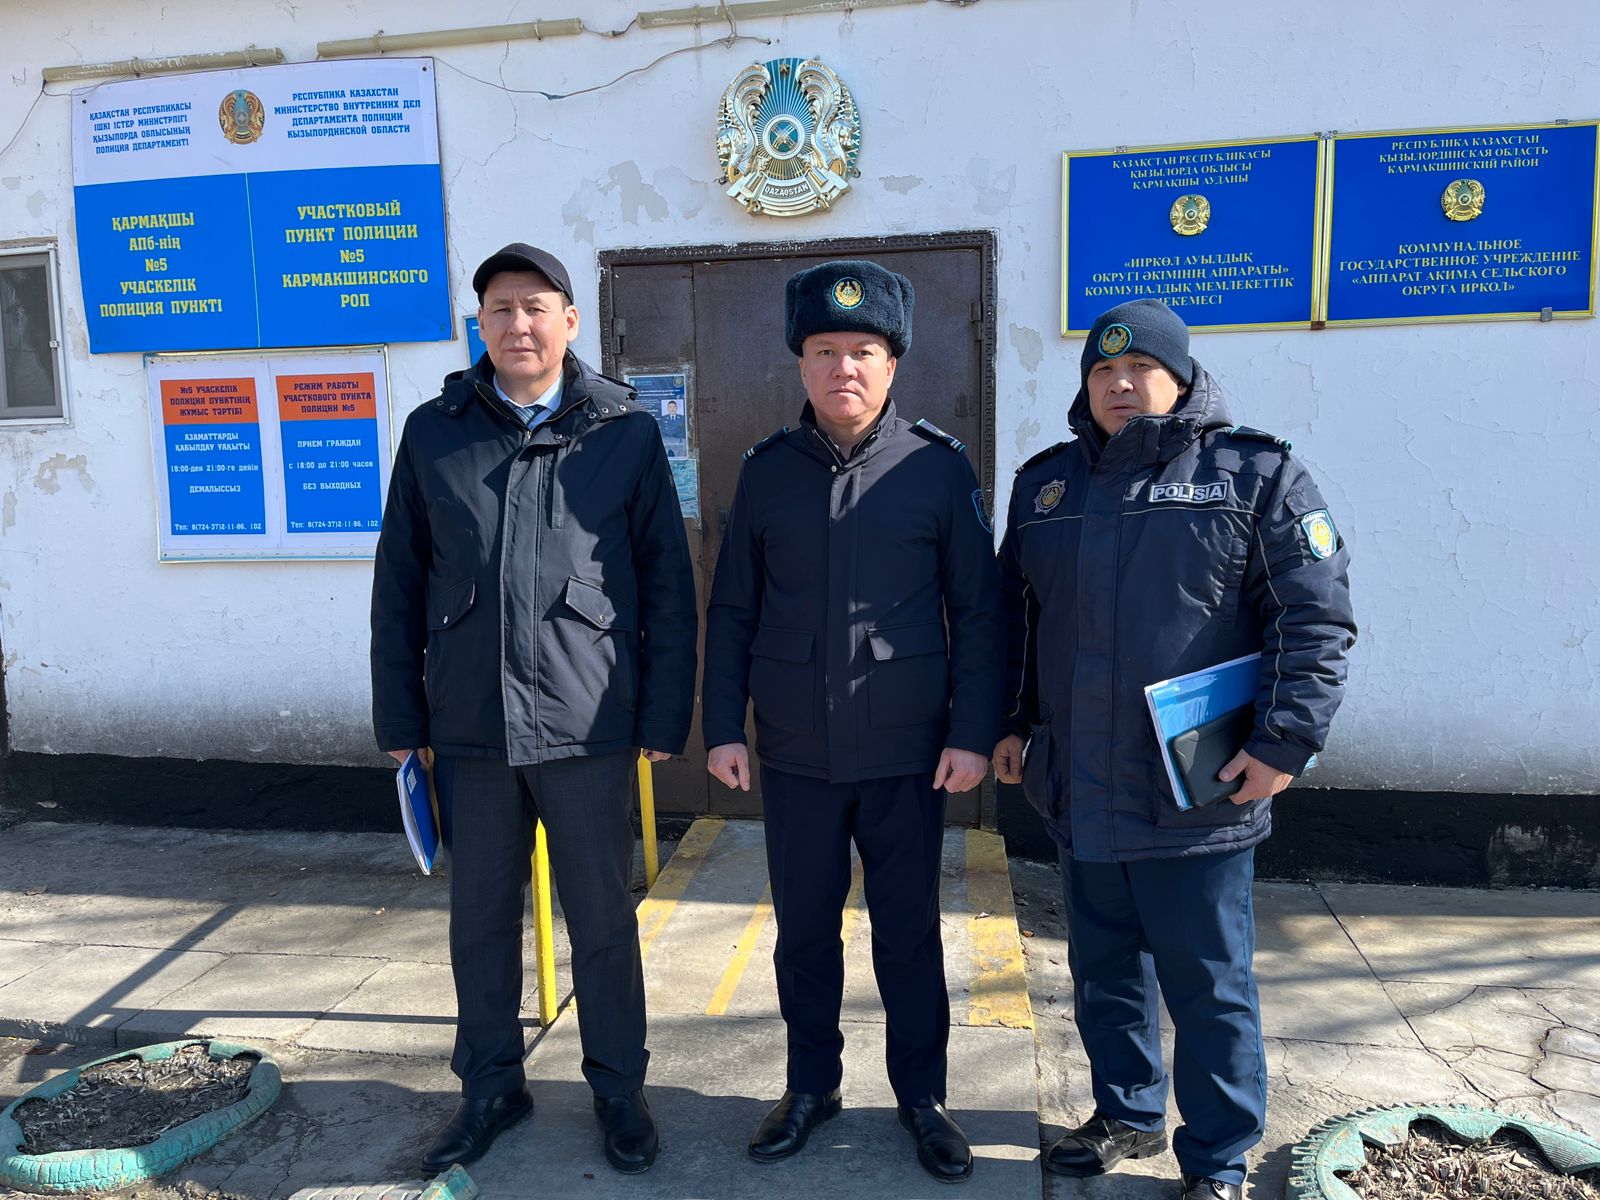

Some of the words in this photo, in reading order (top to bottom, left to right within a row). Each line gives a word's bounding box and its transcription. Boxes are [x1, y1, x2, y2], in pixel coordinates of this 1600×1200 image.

[292, 90, 346, 101] РЕСПУБЛИКА
[350, 88, 398, 98] КАЗАХСТАН
[90, 109, 130, 121] ҚАЗАҚСТАН
[133, 102, 192, 116] РЕСПУБЛИКАСЫ
[274, 103, 339, 115] МИНИСТЕРСТВО
[343, 100, 399, 110] ВНУТРЕННИХ
[403, 100, 420, 109] ДЕЛ
[94, 123, 110, 132] ІШКІ
[114, 120, 134, 129] ІСТЕР
[138, 115, 188, 127] МИНИСТРЛІГІ
[292, 114, 358, 127] ДЕПАРТАМЕНТА
[362, 113, 403, 122] ПОЛИЦИИ
[93, 132, 138, 144] ҚЫЗЫЛОРДА
[141, 126, 191, 138] ОБЛЫСЫНЫҢ
[287, 125, 367, 138] КЫЗЫЛОРДИНСКОЙ
[371, 124, 410, 134] ОБЛАСТИ
[96, 144, 129, 154] ПОЛИЦИЯ
[132, 138, 189, 151] ДЕПАРТАМЕНТІ
[1392, 138, 1469, 150] РЕСПУБЛИКА
[1472, 135, 1540, 147] КАЗАХСТАН
[1179, 150, 1271, 164] РЕСПУБЛИКАСЫ
[1379, 149, 1492, 163] КЫЗЫЛОРДИНСКАЯ
[1495, 146, 1549, 157] ОБЛАСТЬ
[1201, 162, 1251, 173] ОБЛЫСЫ
[1387, 159, 1498, 174] КАРМАКШИНСКИЙ
[1500, 158, 1539, 168] РАЙОН
[1203, 174, 1249, 185] АУДАНЫ
[765, 184, 808, 196] QAZAQSTAN
[297, 199, 401, 220] УЧАСТКОВЫЙ
[112, 212, 195, 232] ҚАРМАҚШЫ
[285, 227, 335, 243] ПУНКТ
[343, 224, 418, 241] ПОЛИЦИИ
[129, 235, 181, 251] АПб-нің
[1399, 239, 1522, 255] КОММУНАЛЬНОЕ
[340, 249, 364, 263] №5
[1184, 252, 1253, 265] АУЫЛДЫҚ
[1340, 255, 1478, 271] ГОСУДАРСТВЕННОЕ
[1483, 251, 1581, 264] УЧРЕЖДЕНИЕ
[145, 258, 168, 272] №5
[282, 269, 428, 288] КАРМАКШИНСКОГО
[1092, 272, 1139, 282] ОКРУГІ
[1142, 268, 1206, 280] ӘКІМІНІҢ
[1210, 264, 1289, 277] АППАРАТЫ»
[1352, 271, 1422, 284] «АППАРАТ
[1426, 269, 1477, 281] АКИМА
[1481, 265, 1566, 278] СЕЛЬСКОГО
[120, 278, 196, 295] УЧАСКЕЛІК
[1085, 282, 1191, 296] КОММУНАЛДЫҚ
[1195, 277, 1294, 292] МЕМЛЕКЕТТІК
[1402, 283, 1457, 296] ОКРУГА
[1461, 282, 1515, 293] ИРКОЛ»
[340, 294, 370, 308] РОП
[1159, 295, 1222, 306] ЕКЕМЕСІ
[100, 301, 164, 317] ПОЛИЦИЯ
[171, 299, 223, 314] ПУНКТІ
[196, 385, 238, 393] УЧАСКЕЛІК
[294, 382, 323, 390] РЕЖИМ
[327, 381, 359, 389] РАБОТЫ
[170, 398, 206, 406] ПОЛИЦИЯ
[284, 394, 337, 402] УЧАСТКОВОГО
[341, 392, 371, 400] ПУНКТА
[301, 405, 338, 413] ПОЛИЦИИ
[342, 404, 355, 412] №5
[184, 433, 238, 441] АЗАМАТТАРДЫ
[326, 439, 361, 447] ГРАЖДАН
[175, 444, 214, 452] ҚАБЫЛДАУ
[218, 443, 250, 451] УАҚЫТЫ
[189, 485, 240, 493] ДЕМАЛЫССЫЗ
[320, 482, 361, 490] ВЫХОДНЫХ
[1154, 485, 1223, 501] POLISIA
